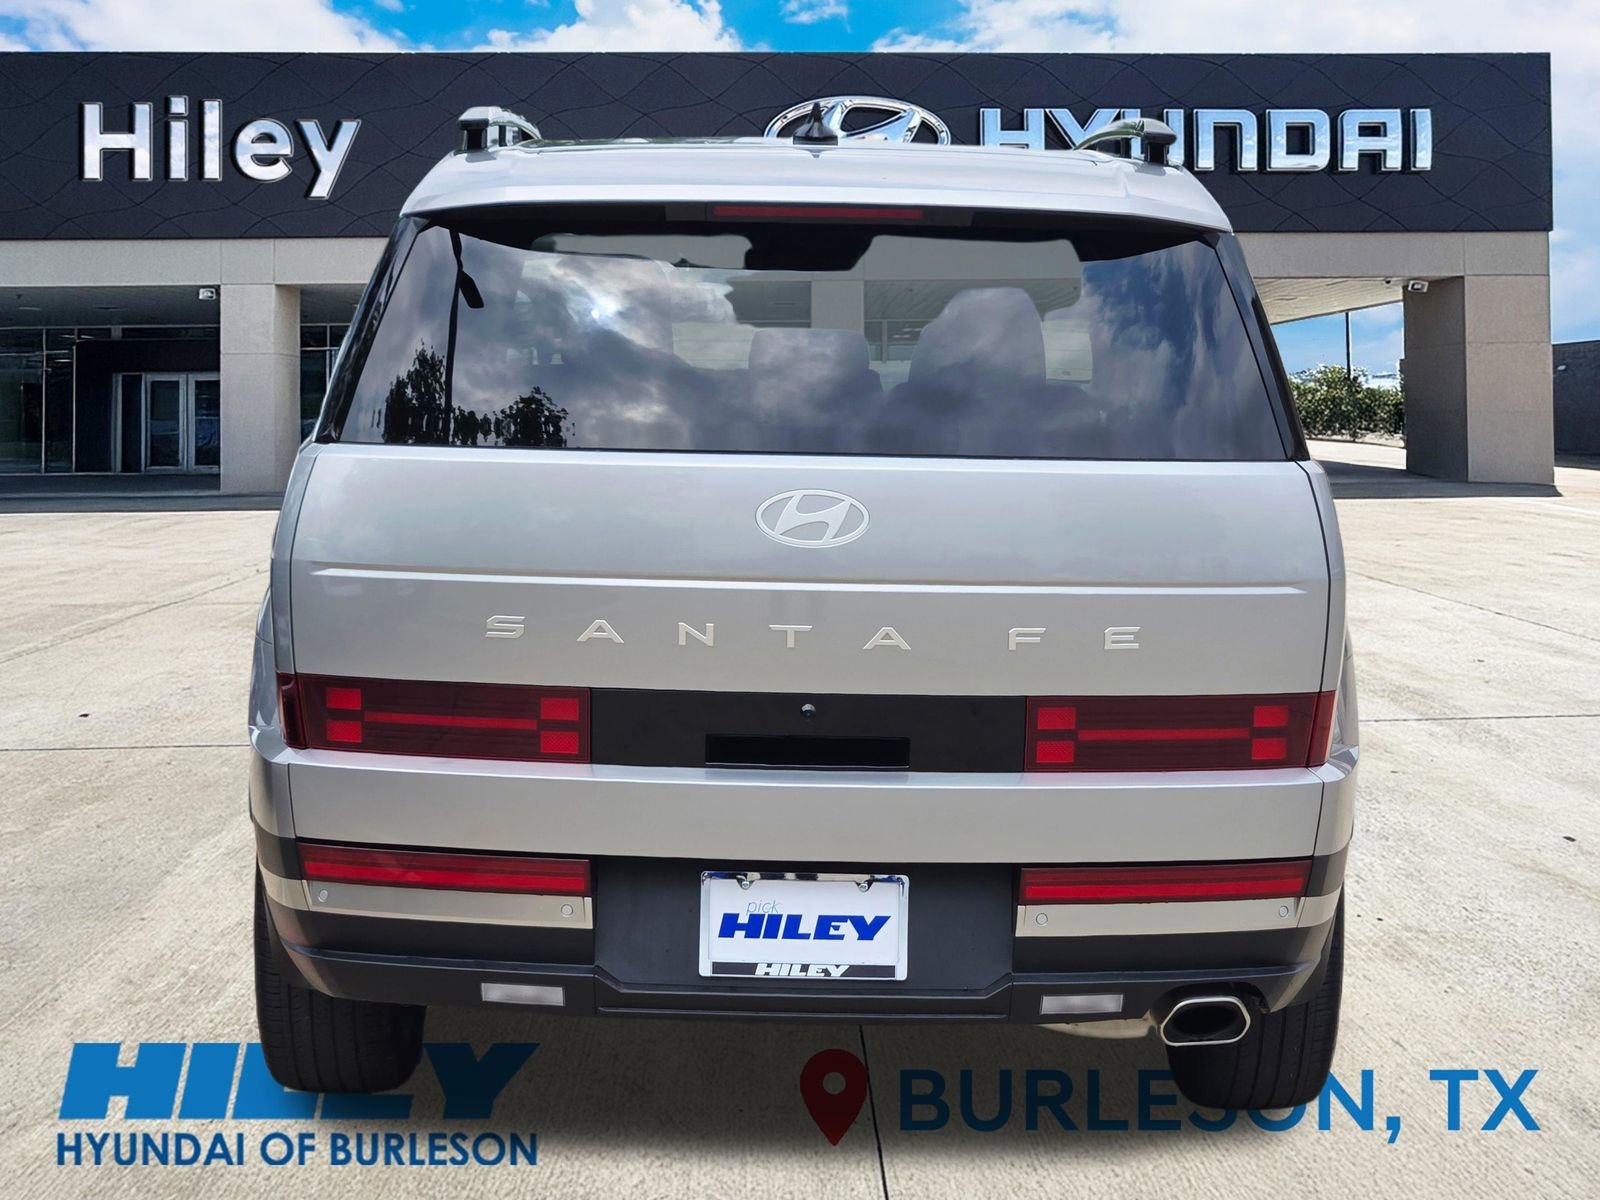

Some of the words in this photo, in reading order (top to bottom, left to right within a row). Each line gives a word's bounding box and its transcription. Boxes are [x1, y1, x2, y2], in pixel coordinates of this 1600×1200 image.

[81, 95, 361, 200] Hiley
[485, 614, 912, 650] SANTA
[1007, 625, 1141, 650] FE
[746, 899, 782, 915] pick
[717, 912, 892, 941] HILEY
[754, 962, 850, 977] HILEY
